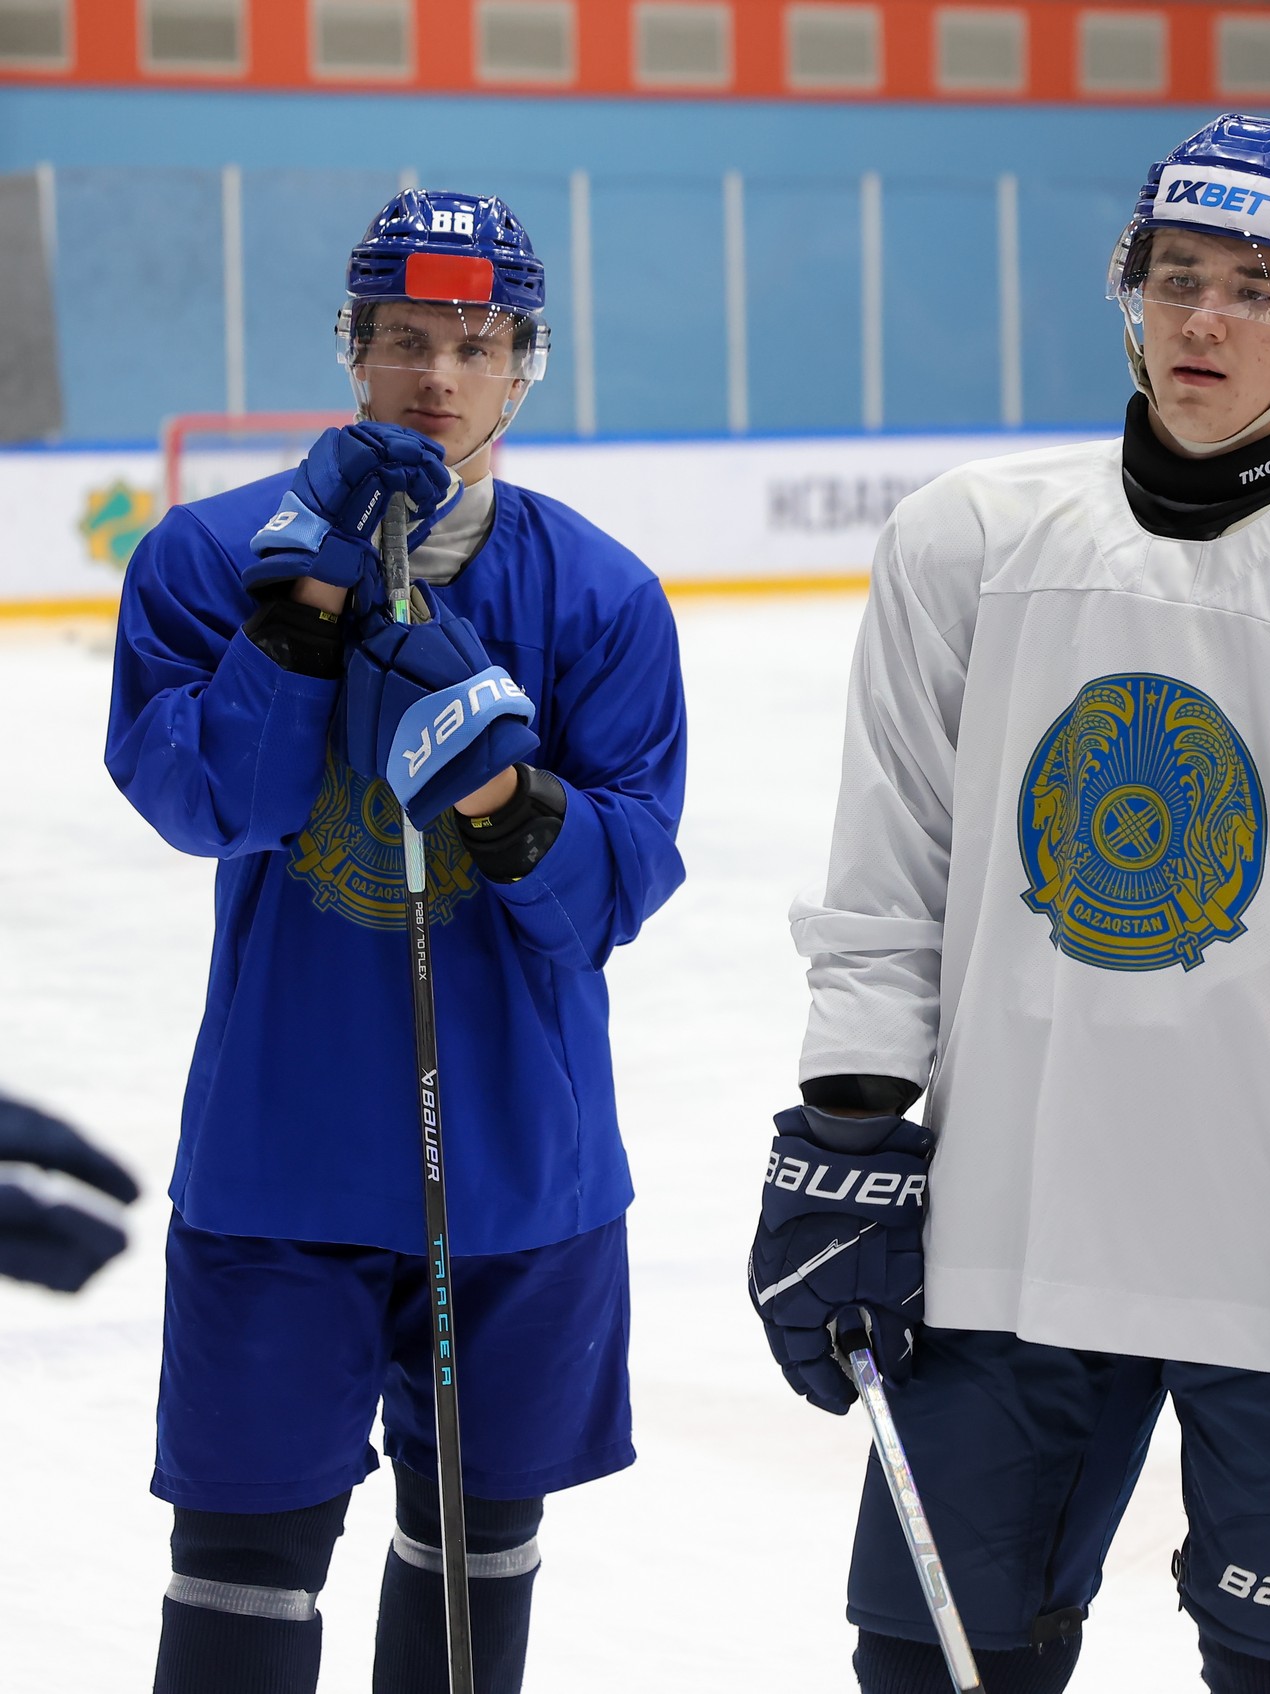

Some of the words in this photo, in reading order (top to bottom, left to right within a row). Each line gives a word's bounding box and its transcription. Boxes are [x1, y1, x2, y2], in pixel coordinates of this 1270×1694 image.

[431, 210, 474, 235] 88
[357, 489, 382, 531] BAUER
[402, 678, 526, 778] AUER
[351, 876, 406, 900] QAZAQST
[415, 901, 424, 925] P28
[1074, 903, 1162, 934] QAZAQSTAN
[418, 951, 428, 981] FLEX
[422, 1088, 439, 1183] BAUER
[765, 1151, 927, 1207] BAUER
[433, 1233, 452, 1386] TRACER
